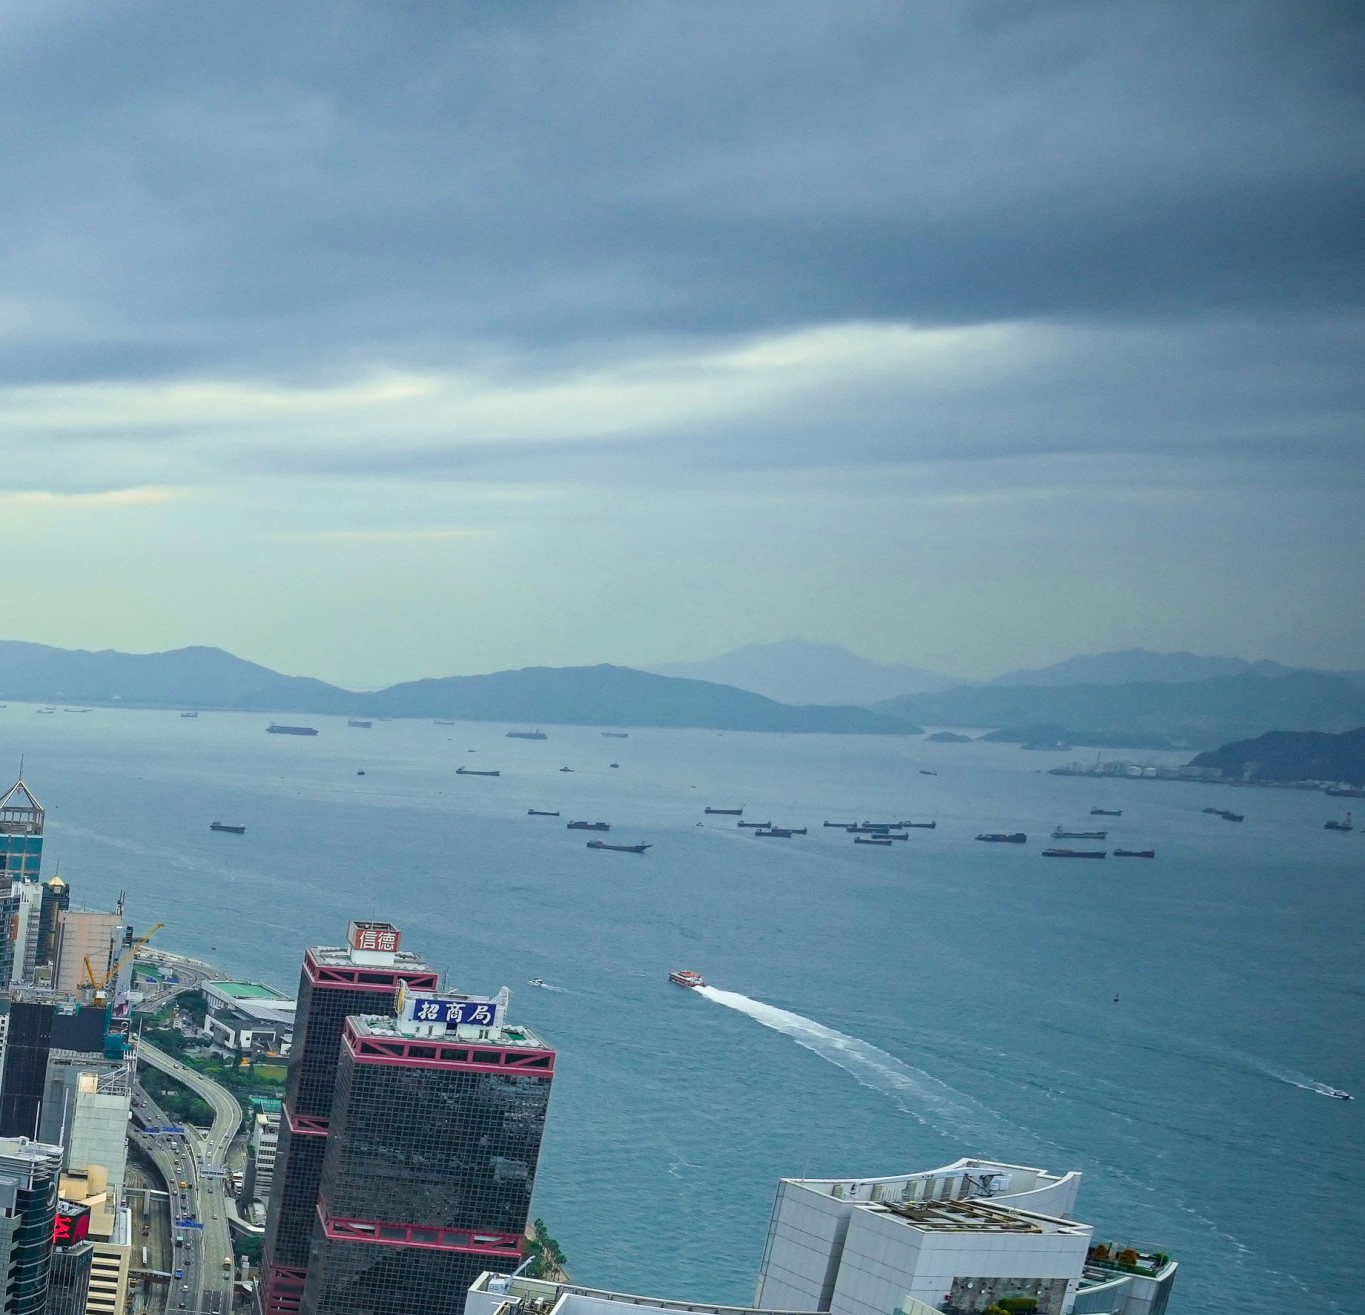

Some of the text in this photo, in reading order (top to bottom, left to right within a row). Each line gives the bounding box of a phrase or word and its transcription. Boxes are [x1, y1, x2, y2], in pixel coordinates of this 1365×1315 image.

[359, 931, 396, 950] 信德
[418, 1001, 492, 1024] 招商局
